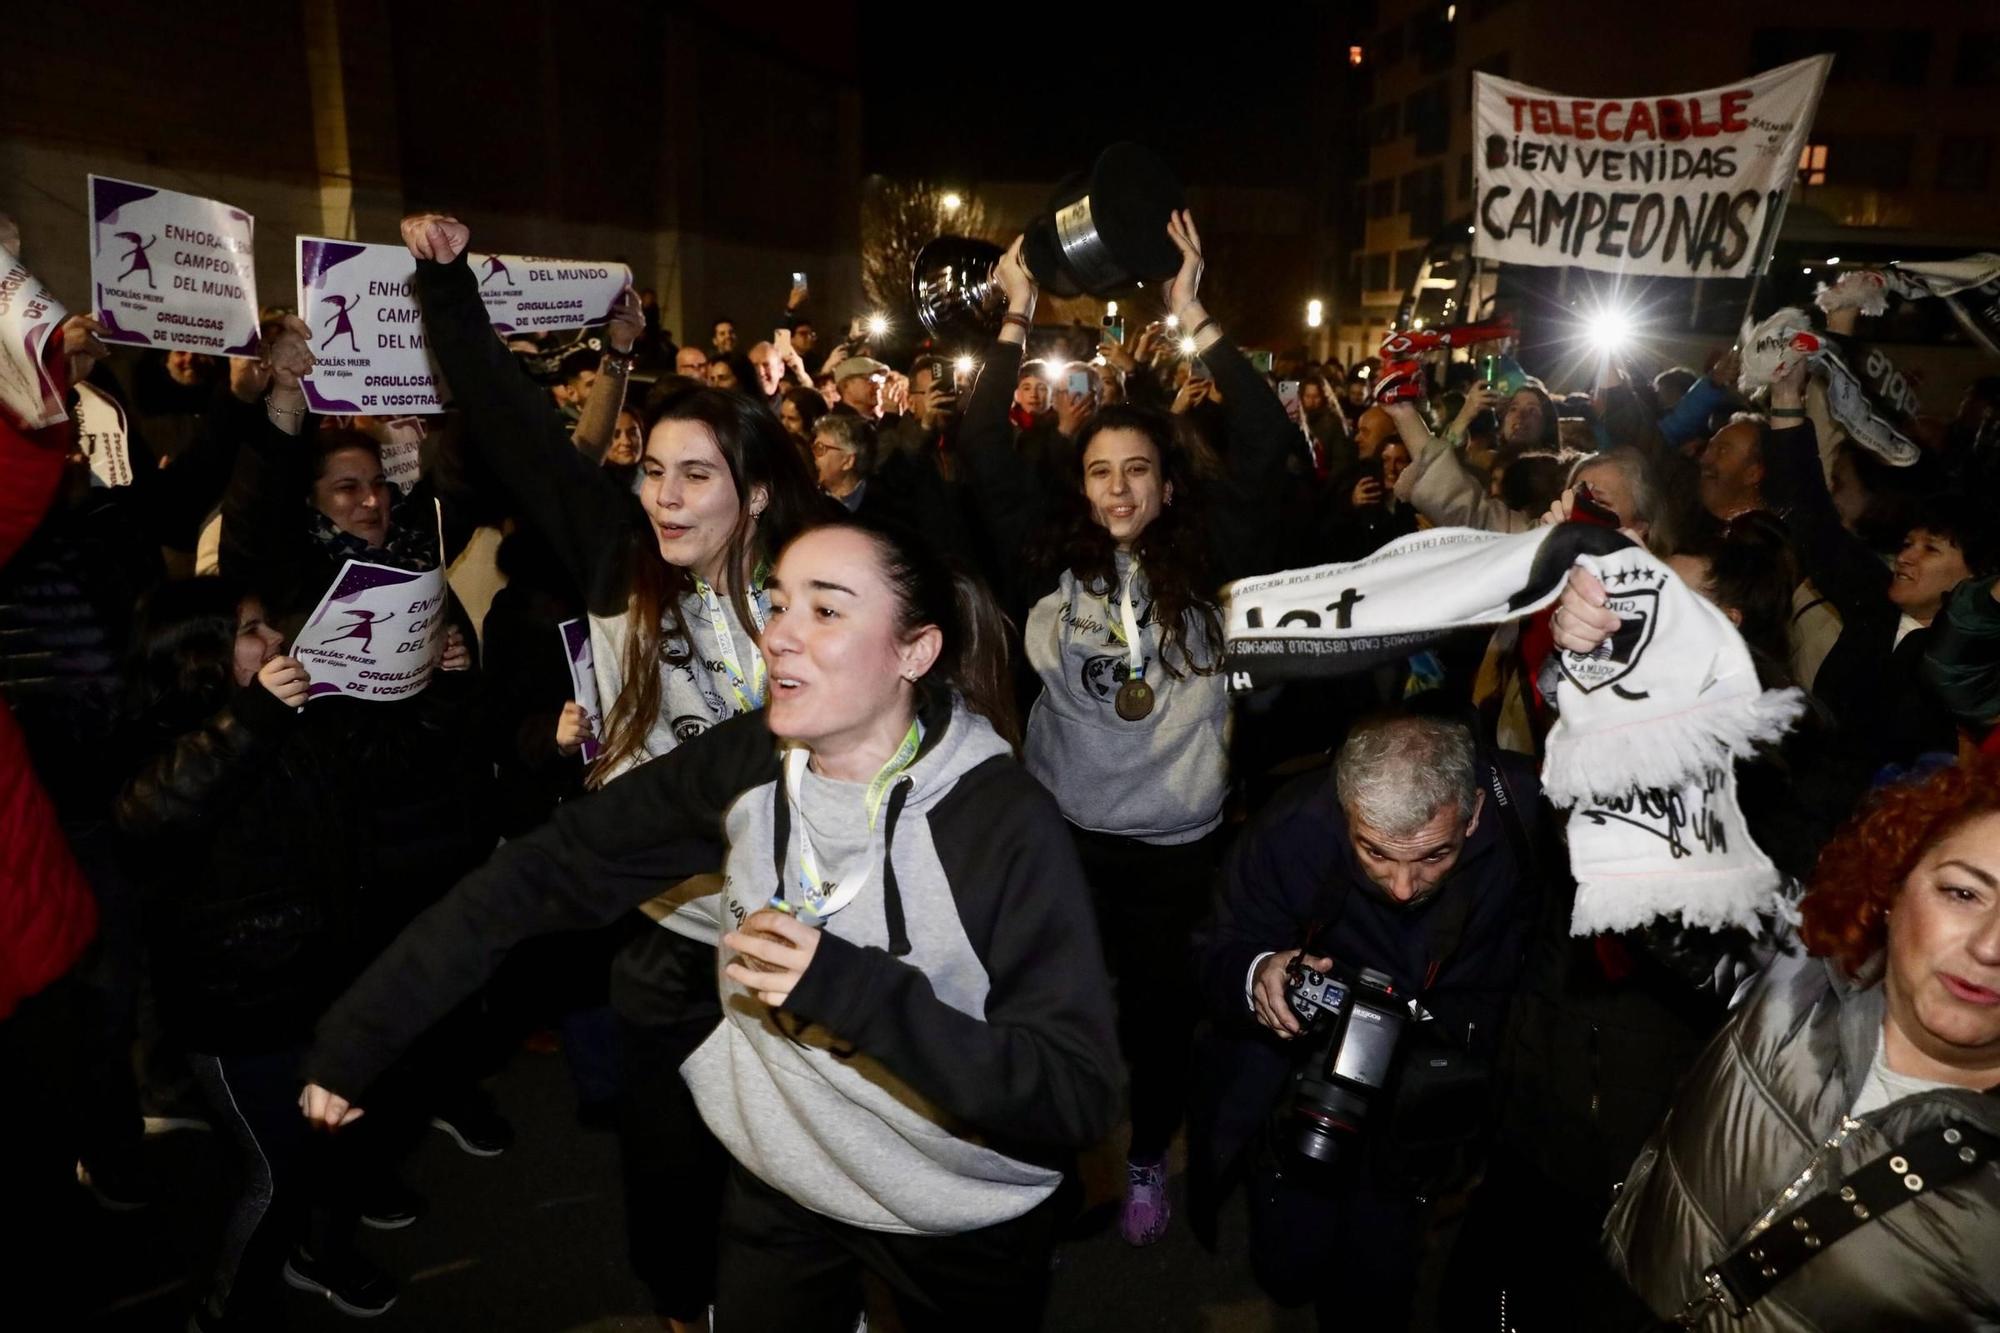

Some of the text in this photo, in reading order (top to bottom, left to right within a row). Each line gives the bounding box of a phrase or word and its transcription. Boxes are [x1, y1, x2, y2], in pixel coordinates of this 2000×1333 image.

[1505, 90, 1754, 142] TELECABLE
[529, 268, 609, 282] DEL MUNDO
[173, 275, 198, 292] DEL
[517, 300, 583, 311] ORGULLOSAS
[156, 312, 224, 331] ORGULLOSAS
[516, 314, 585, 326] DE VOSOTRAS
[153, 330, 225, 348] DE VOSOTRAS
[378, 334, 405, 349] DEL
[314, 356, 371, 367] OCALÍAS MUJER
[364, 376, 439, 387] ORGULLOSAS
[362, 394, 443, 406] DE VOSOTRAS
[396, 638, 425, 653] DEL
[1237, 639, 1284, 655] ROMPEMOS
[1350, 637, 1381, 652] CADA
[300, 647, 377, 666] VOCALÍAS MUJER
[345, 682, 368, 692] DE
[1489, 766, 1508, 807] Canon
